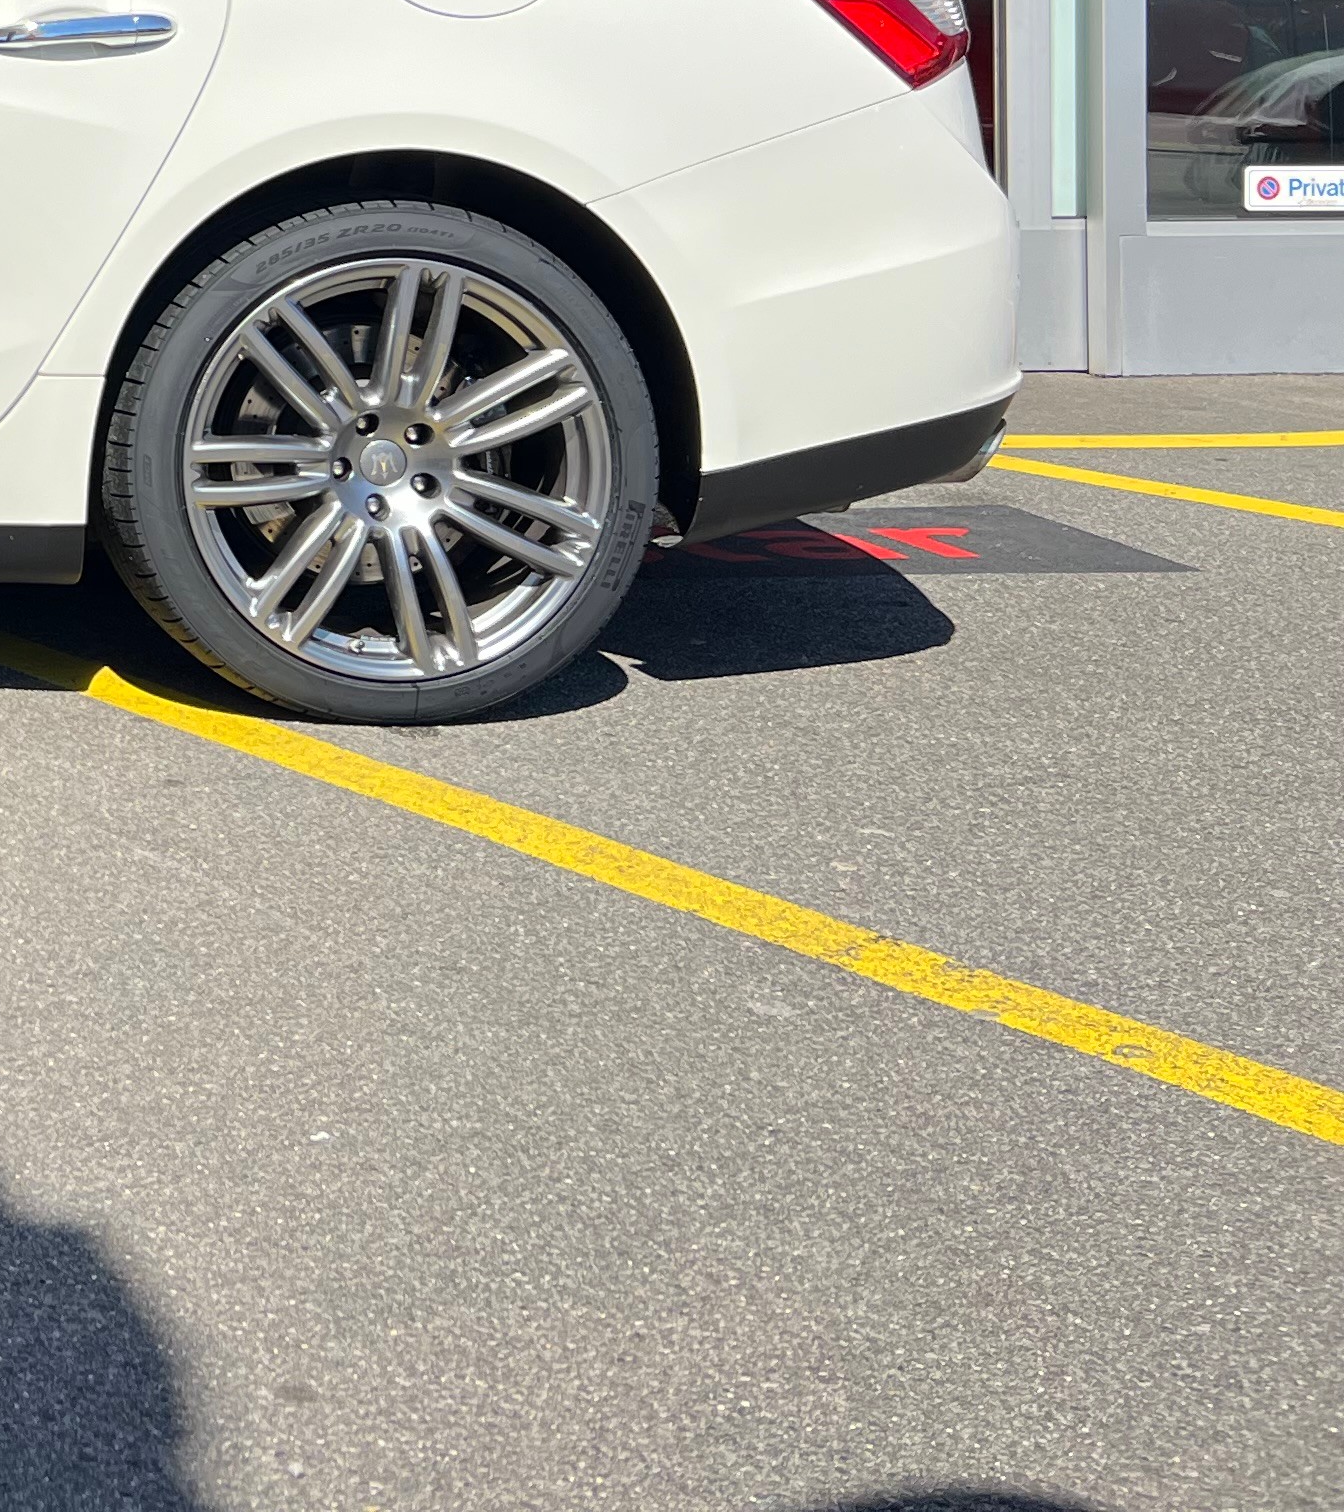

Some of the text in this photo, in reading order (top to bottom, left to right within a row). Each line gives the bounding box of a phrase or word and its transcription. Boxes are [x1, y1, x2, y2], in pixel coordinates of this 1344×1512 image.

[255, 233, 330, 274] 285/35
[335, 222, 403, 240] ZR20
[599, 499, 647, 592] PIRELLI
